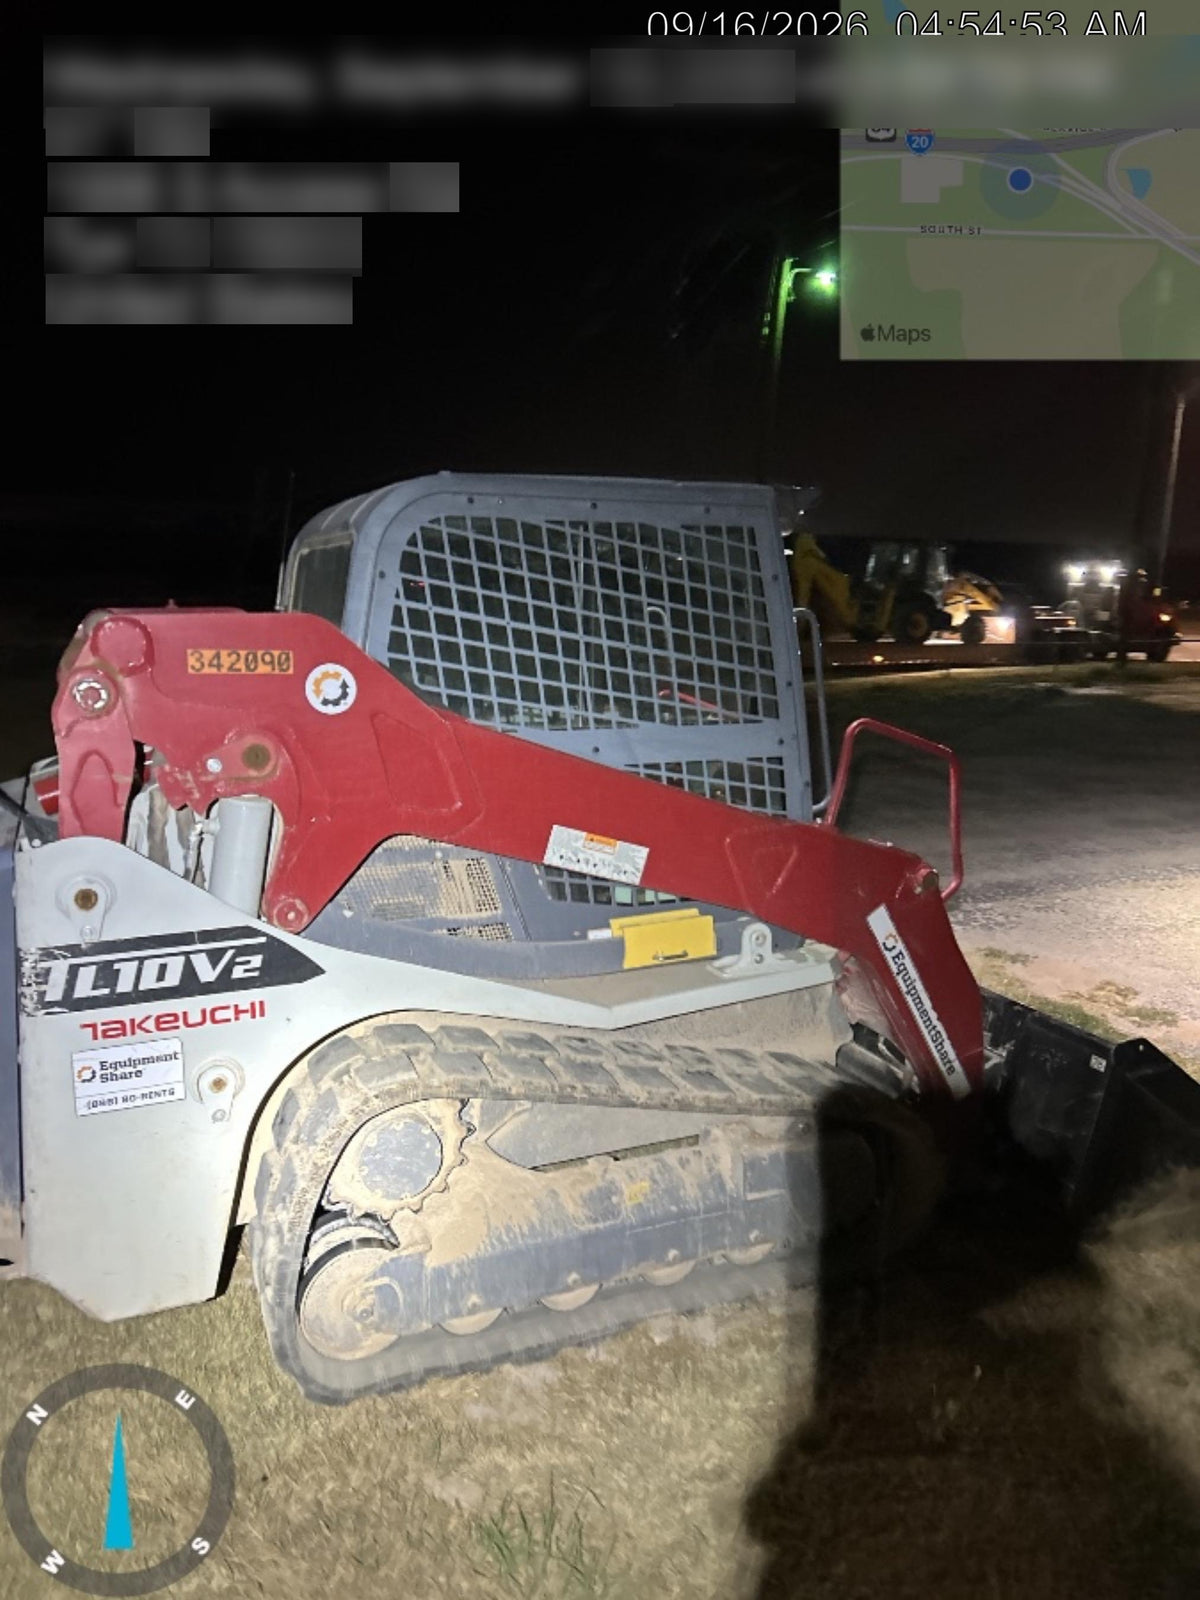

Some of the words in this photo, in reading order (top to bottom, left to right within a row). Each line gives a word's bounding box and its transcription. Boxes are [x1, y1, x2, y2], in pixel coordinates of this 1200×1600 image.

[189, 649, 291, 673] 342090
[892, 950, 956, 1076] EquipmentShare
[99, 1050, 180, 1071] Equipment
[100, 1069, 143, 1083] Share
